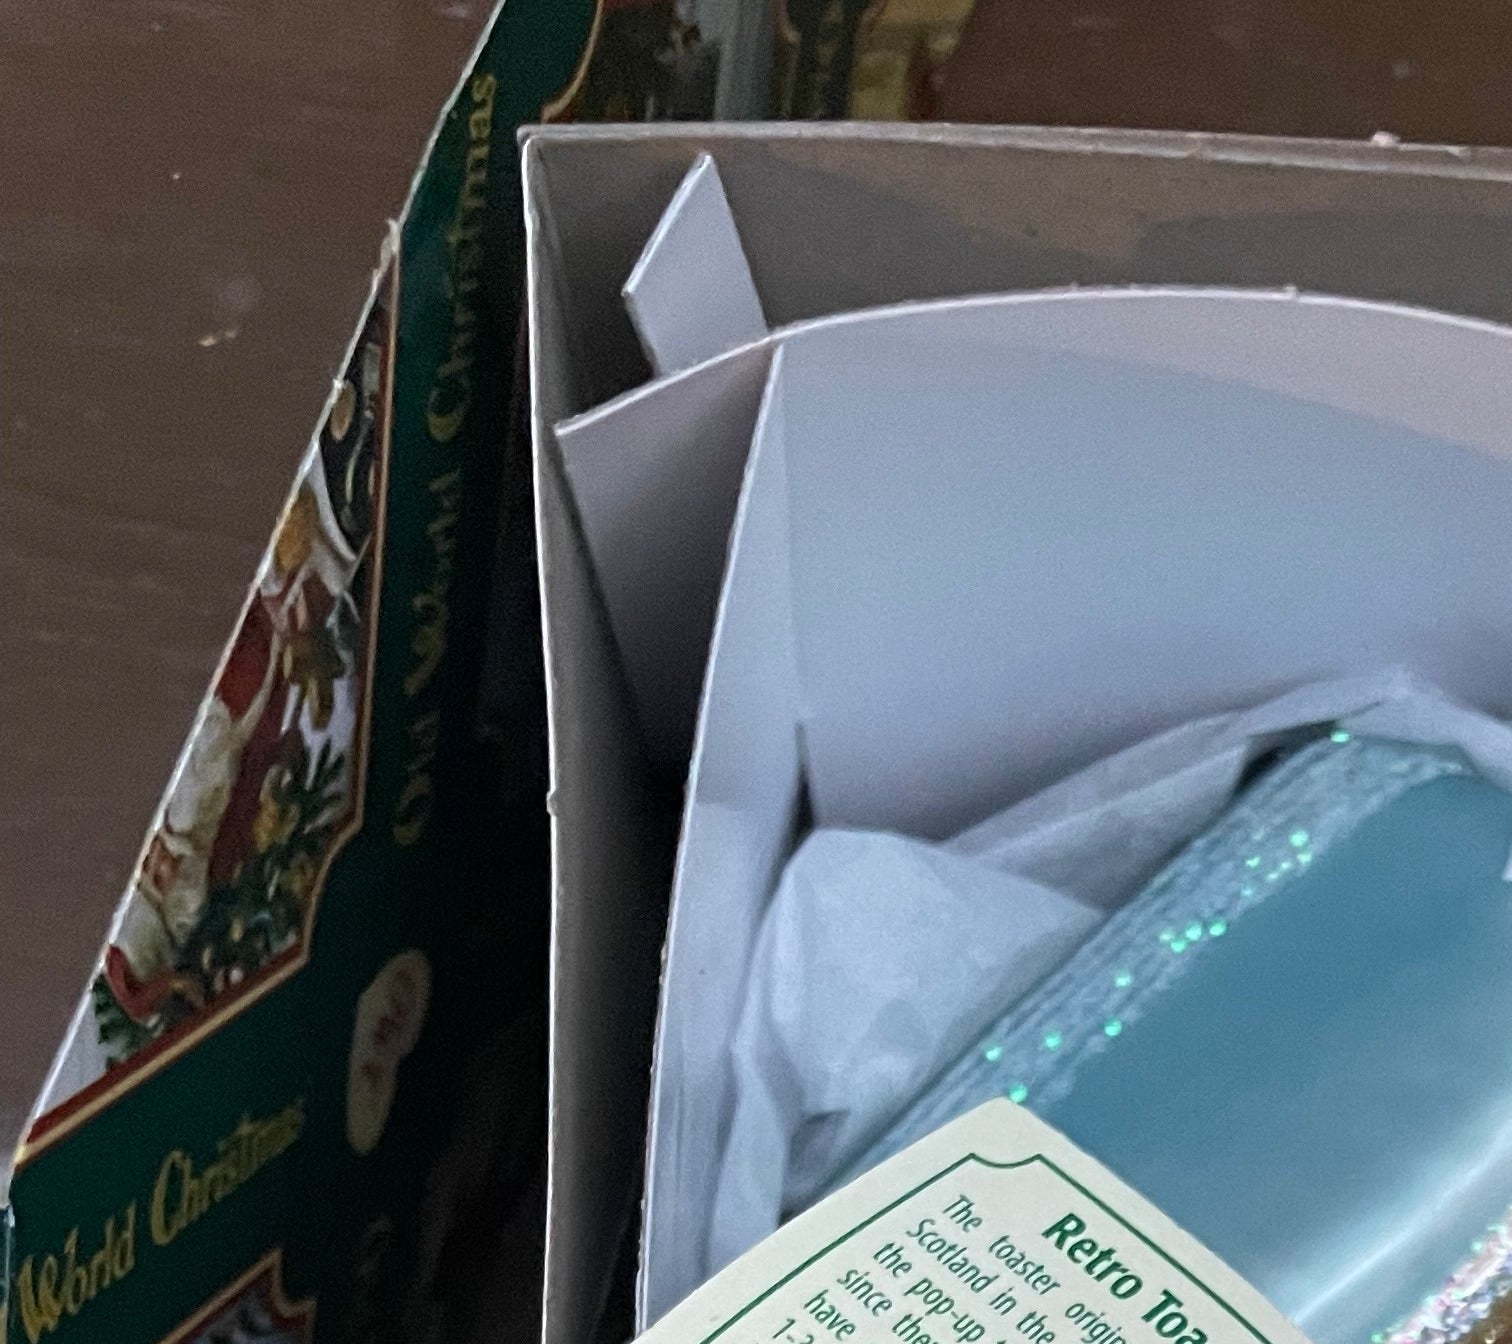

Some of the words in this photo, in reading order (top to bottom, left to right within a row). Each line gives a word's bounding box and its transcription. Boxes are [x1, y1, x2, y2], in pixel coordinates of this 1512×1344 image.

[18, 1197, 137, 1344] World
[836, 1269, 893, 1317] since
[872, 1241, 913, 1279] the
[902, 1277, 986, 1344] pop-up
[905, 1218, 1000, 1294] Scotland
[988, 1286, 1017, 1316] in
[942, 1194, 983, 1233] The
[988, 1234, 1061, 1296] toaster
[1040, 1212, 1144, 1300] Retro
[803, 1288, 857, 1342] have
